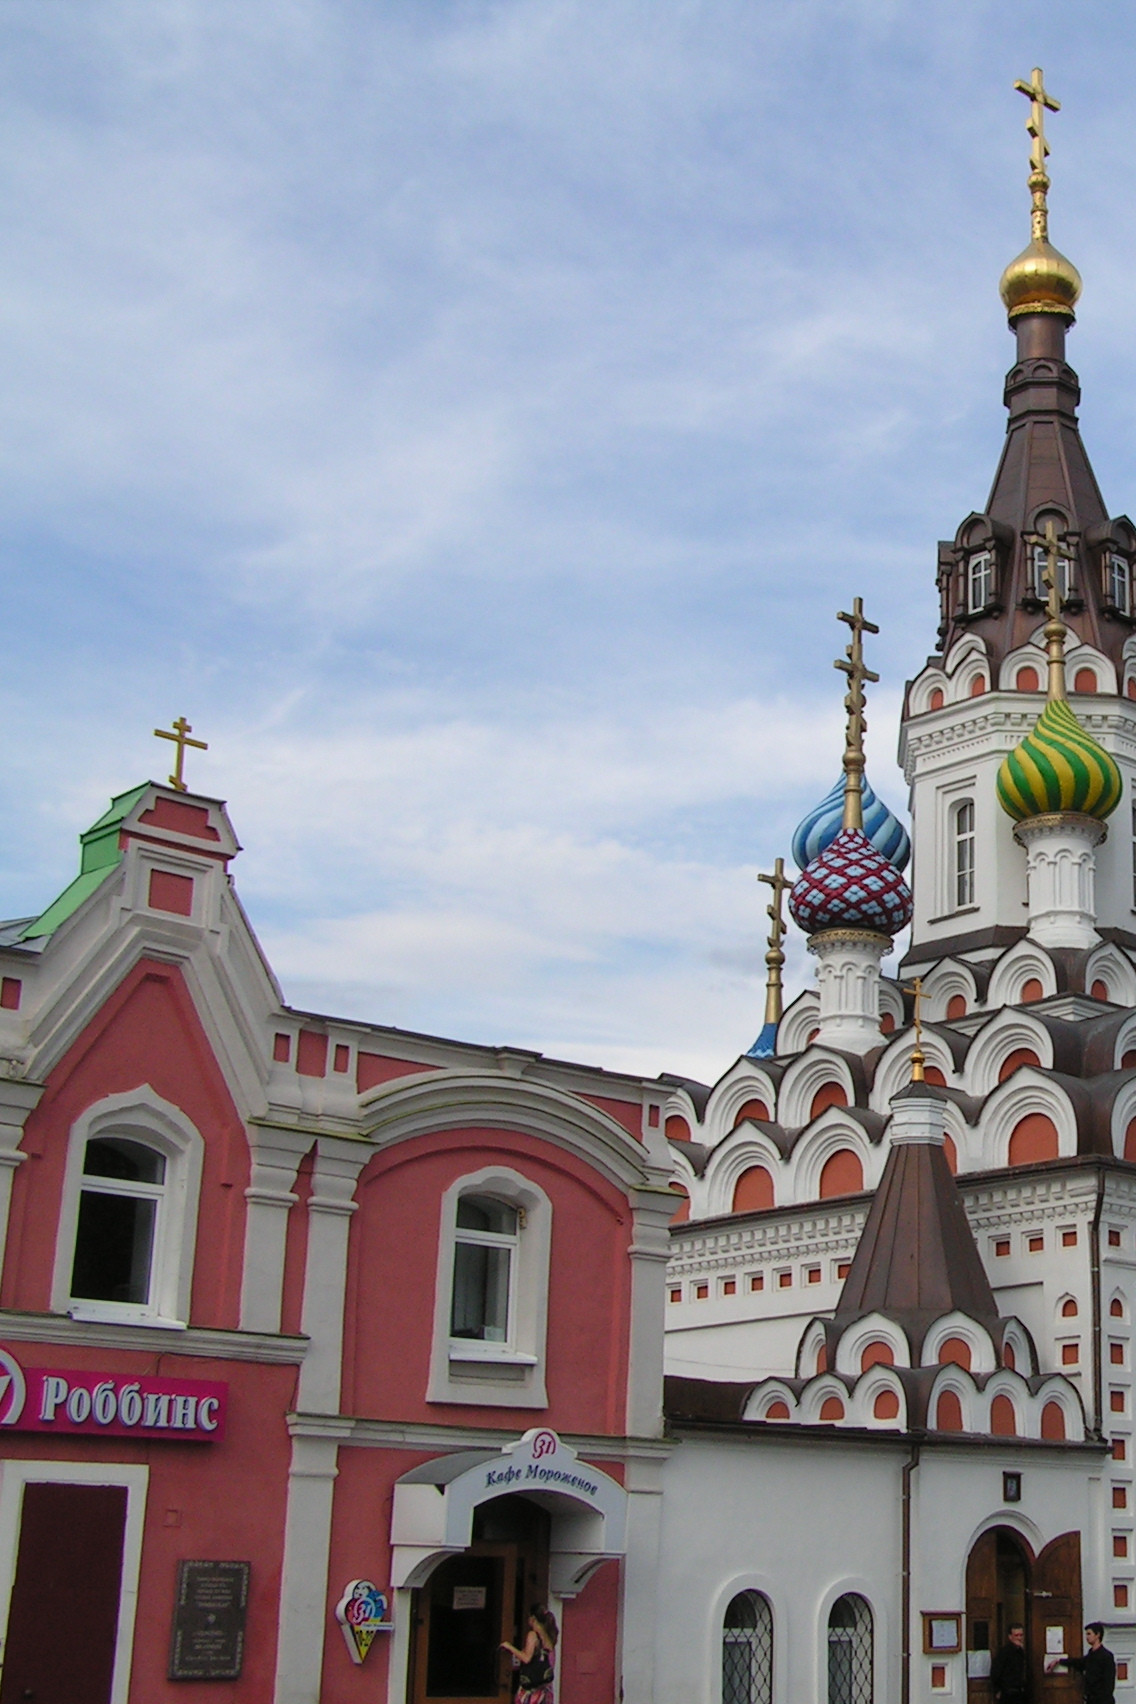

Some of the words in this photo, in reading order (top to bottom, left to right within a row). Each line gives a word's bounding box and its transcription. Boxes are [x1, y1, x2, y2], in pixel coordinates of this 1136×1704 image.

[39, 1375, 219, 1431] Роббинс
[532, 1434, 555, 1459] 31
[485, 1465, 522, 1488] Кафе
[525, 1464, 599, 1496] Мороженое
